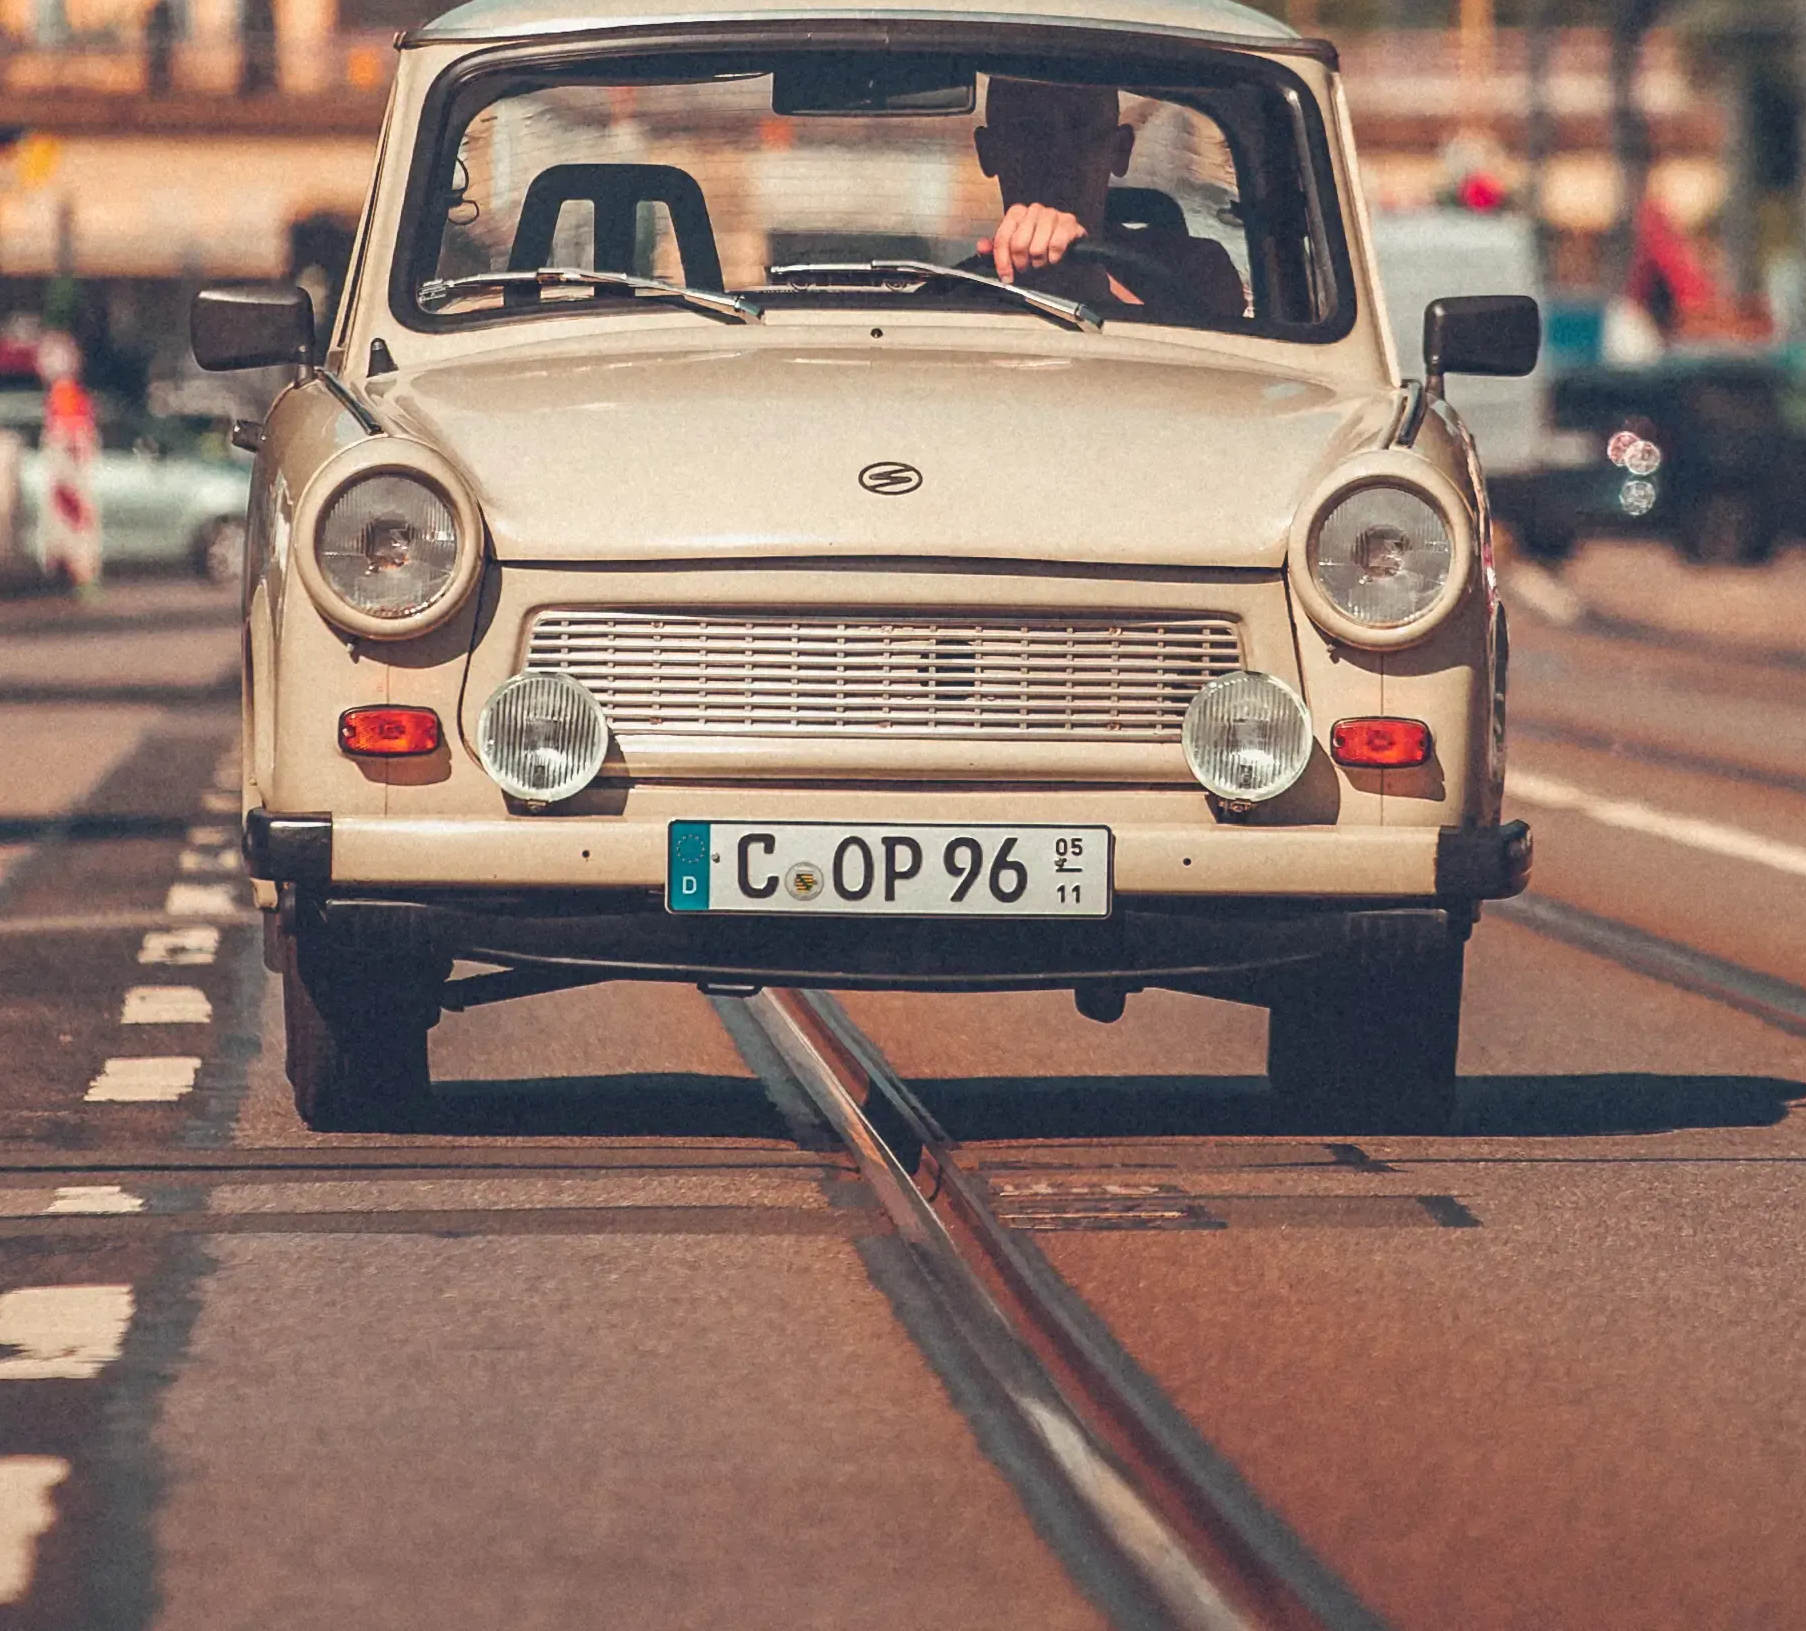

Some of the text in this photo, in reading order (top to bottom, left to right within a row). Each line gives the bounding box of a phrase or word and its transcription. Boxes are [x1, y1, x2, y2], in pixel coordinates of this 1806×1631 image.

[1055, 838, 1083, 857] 05
[736, 832, 1028, 903] C OP 96
[682, 876, 698, 895] D
[1055, 884, 1081, 904] 11
